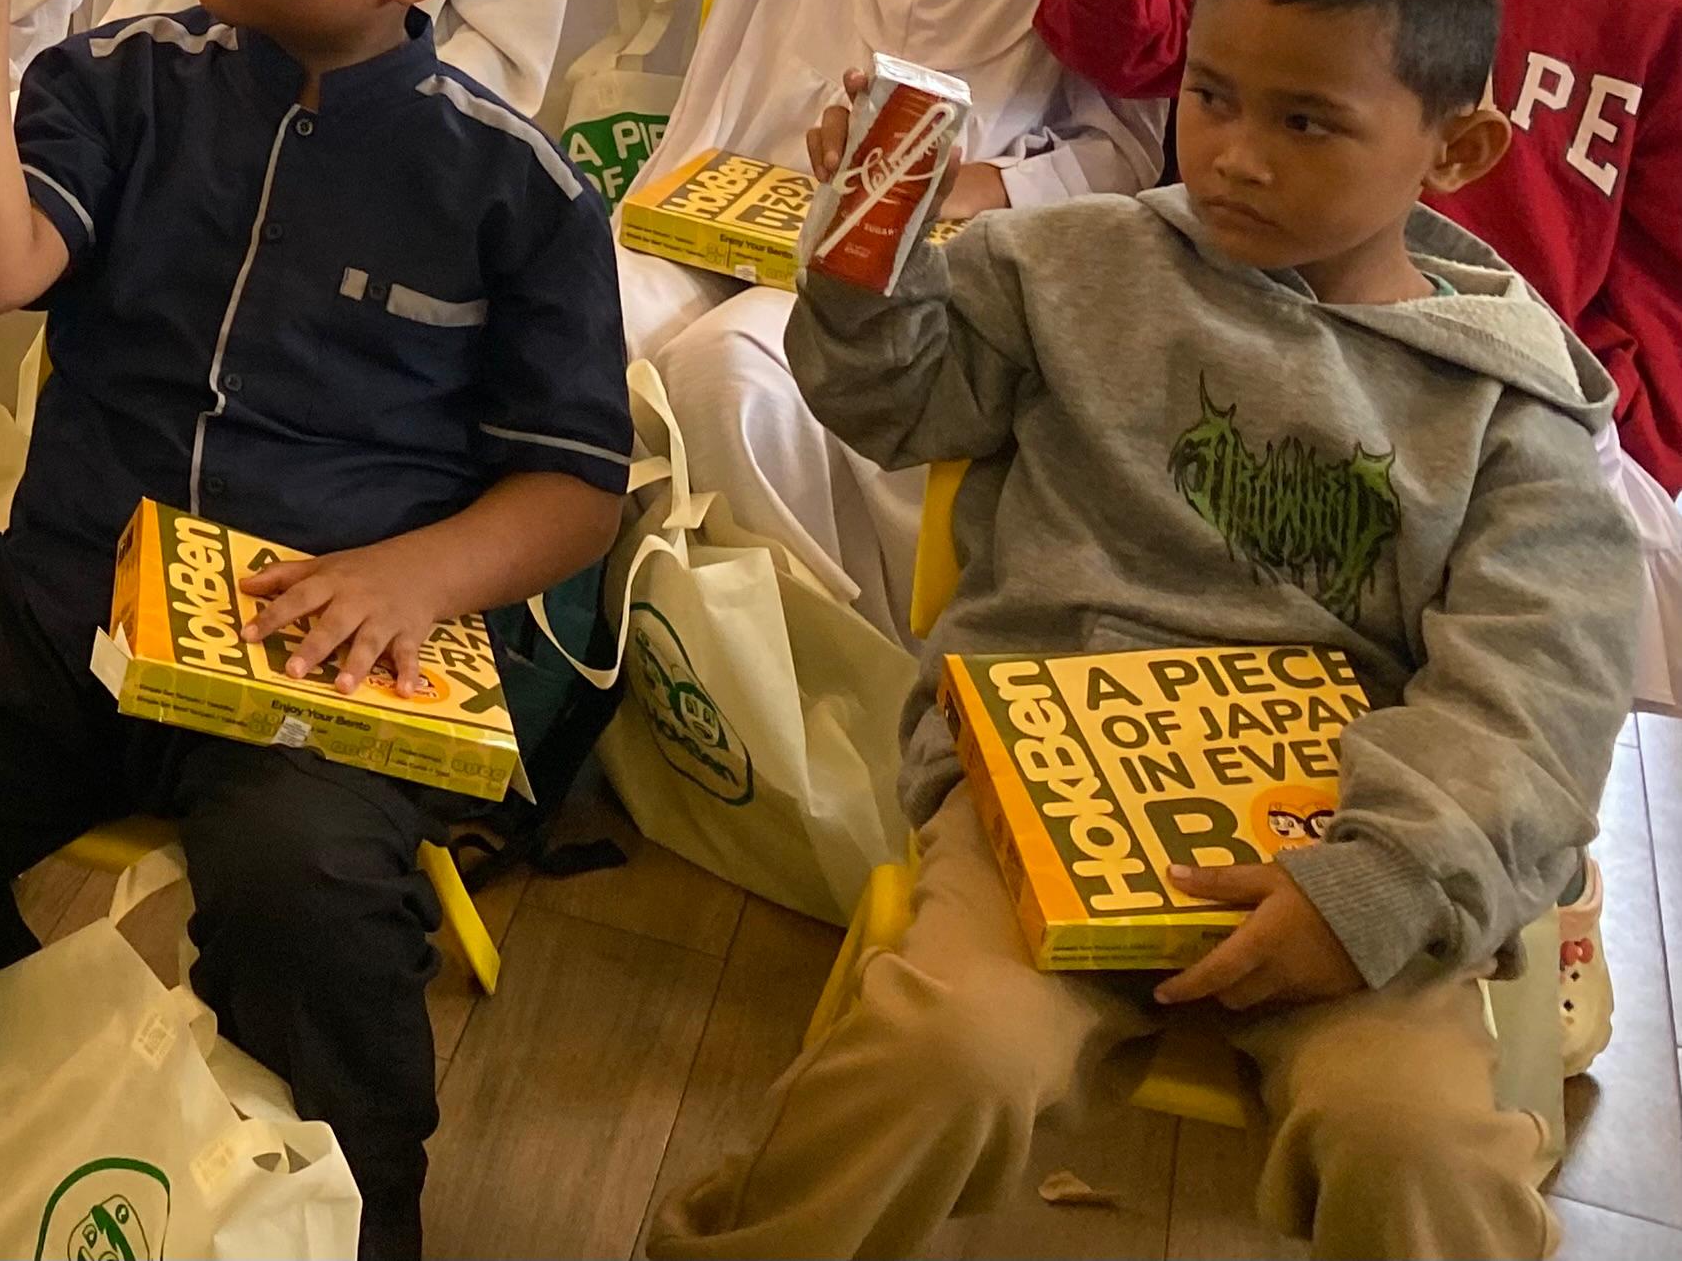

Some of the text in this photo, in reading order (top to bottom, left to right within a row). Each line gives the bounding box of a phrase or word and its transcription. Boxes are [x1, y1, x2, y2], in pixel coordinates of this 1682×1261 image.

[568, 132, 603, 167] A
[662, 156, 772, 221] HokBen
[169, 516, 250, 676] HokBen
[1086, 648, 1359, 711] A PIECE
[270, 699, 372, 732] Enjoy Your Bento
[1101, 710, 1183, 750] OF
[989, 661, 1164, 912] HokBen
[1118, 751, 1196, 795] IN
